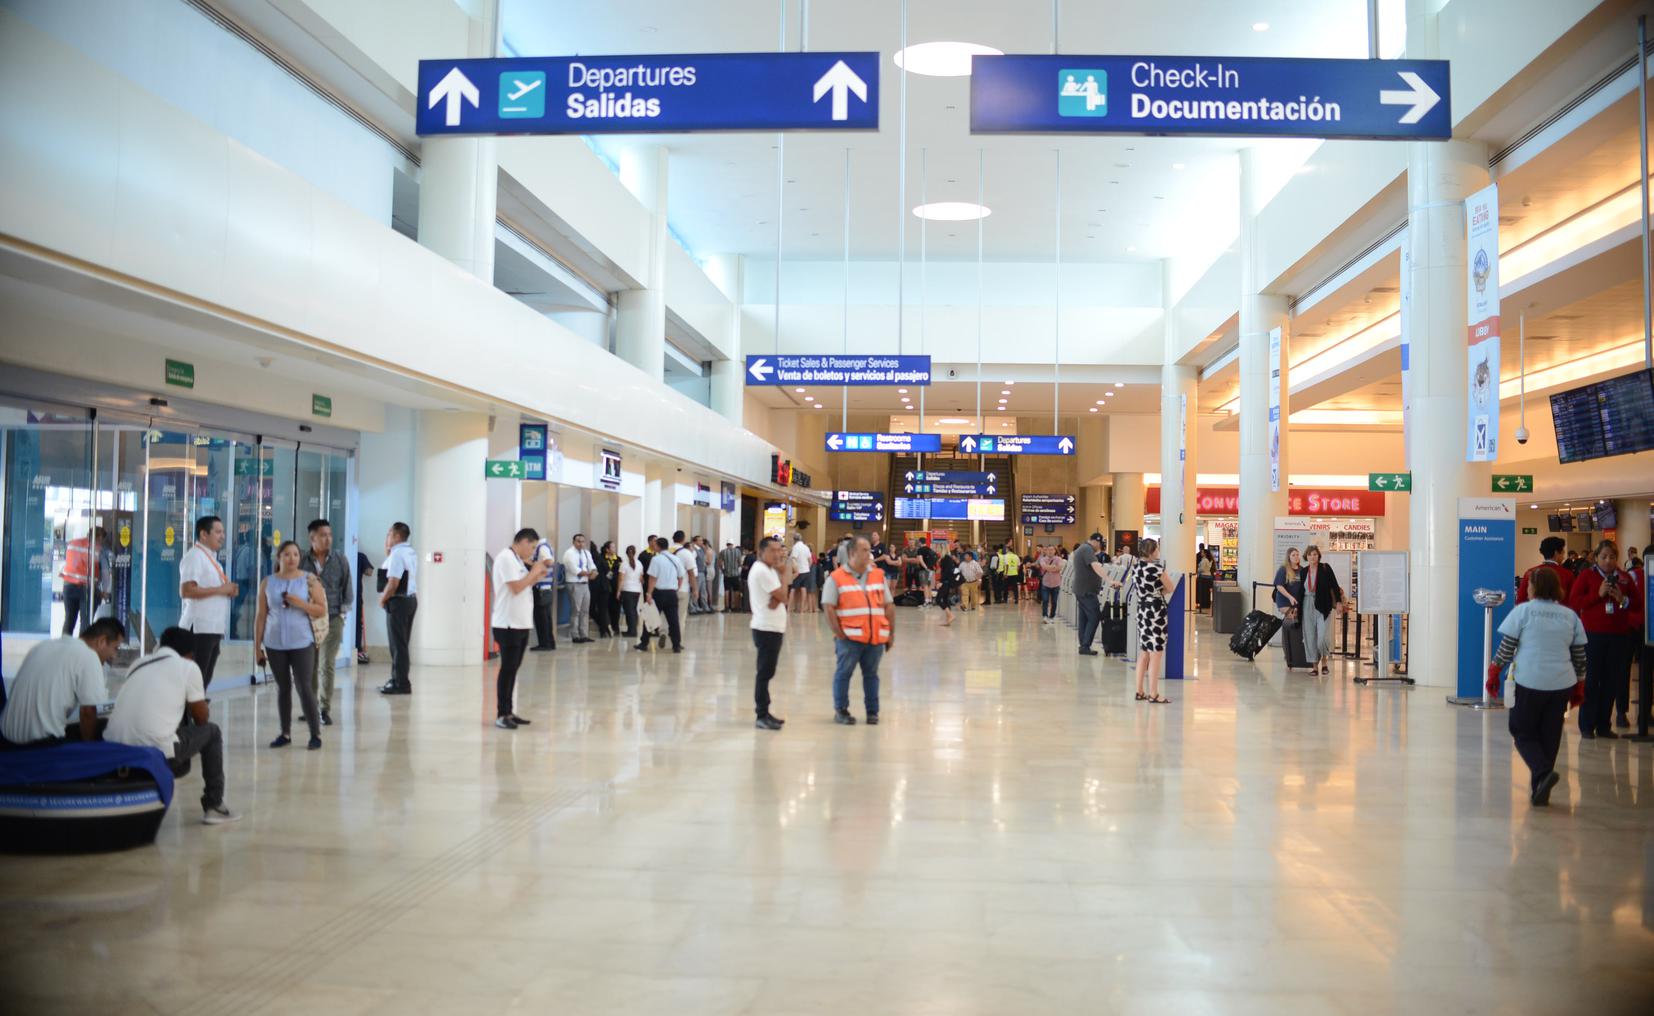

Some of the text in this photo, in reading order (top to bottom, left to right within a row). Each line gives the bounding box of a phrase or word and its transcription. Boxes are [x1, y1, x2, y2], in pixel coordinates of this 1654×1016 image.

[568, 62, 697, 92] Departures
[1131, 62, 1240, 88] Check-In
[566, 92, 661, 118] Salidas
[1131, 93, 1341, 121] Documentación
[778, 357, 899, 370] Ticket Sales & Passenger Services
[778, 370, 929, 382] Venta de boletos y servicios al pasajero
[998, 436, 1031, 445] Departures
[1464, 525, 1488, 533] MAIN
